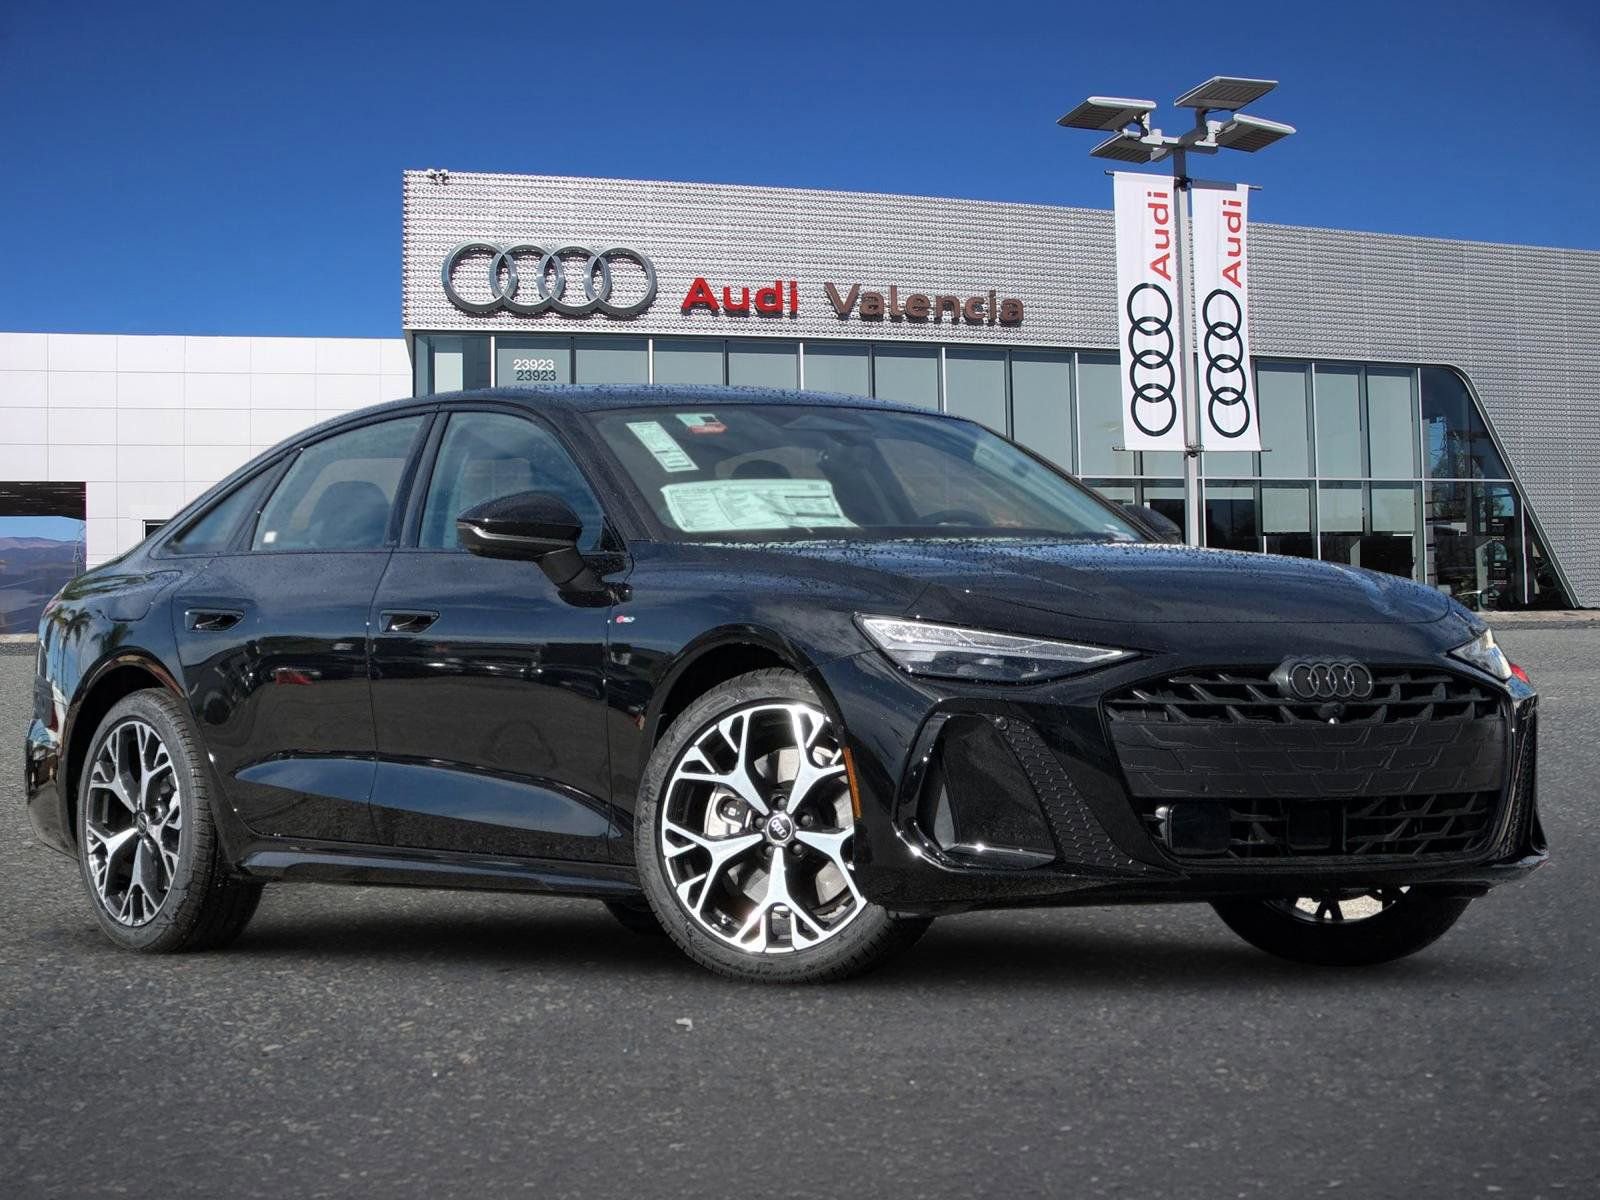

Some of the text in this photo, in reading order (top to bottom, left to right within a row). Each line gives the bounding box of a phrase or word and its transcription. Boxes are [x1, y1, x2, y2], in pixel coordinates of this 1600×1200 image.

[1147, 191, 1171, 281] Audi
[1222, 199, 1242, 288] Audi
[681, 276, 1024, 326] Audi Valencia
[513, 359, 554, 370] 23923
[516, 370, 556, 381] 23923
